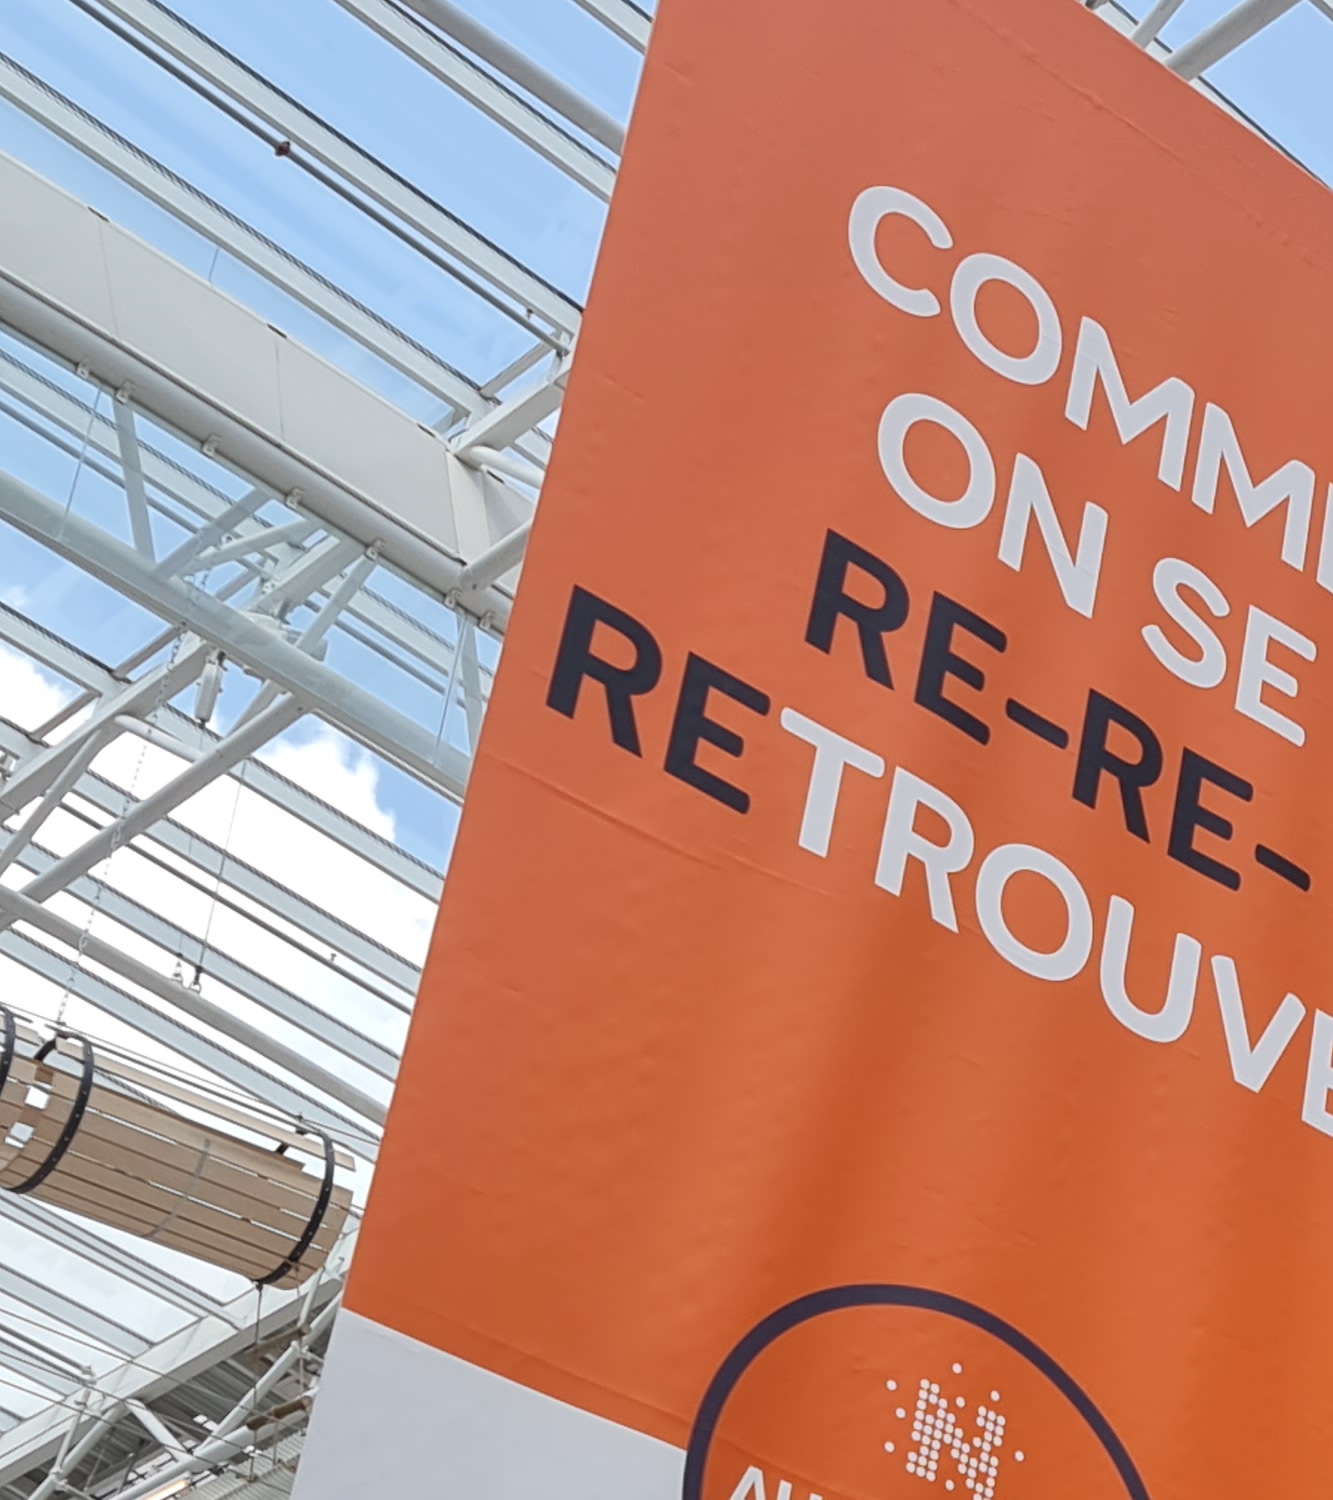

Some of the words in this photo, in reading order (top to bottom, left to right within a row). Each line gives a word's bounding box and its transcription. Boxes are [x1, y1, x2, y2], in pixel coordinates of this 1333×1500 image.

[804, 528, 1311, 892] RE-RE-
[876, 392, 1108, 618] ON
[1141, 556, 1318, 747] SE
